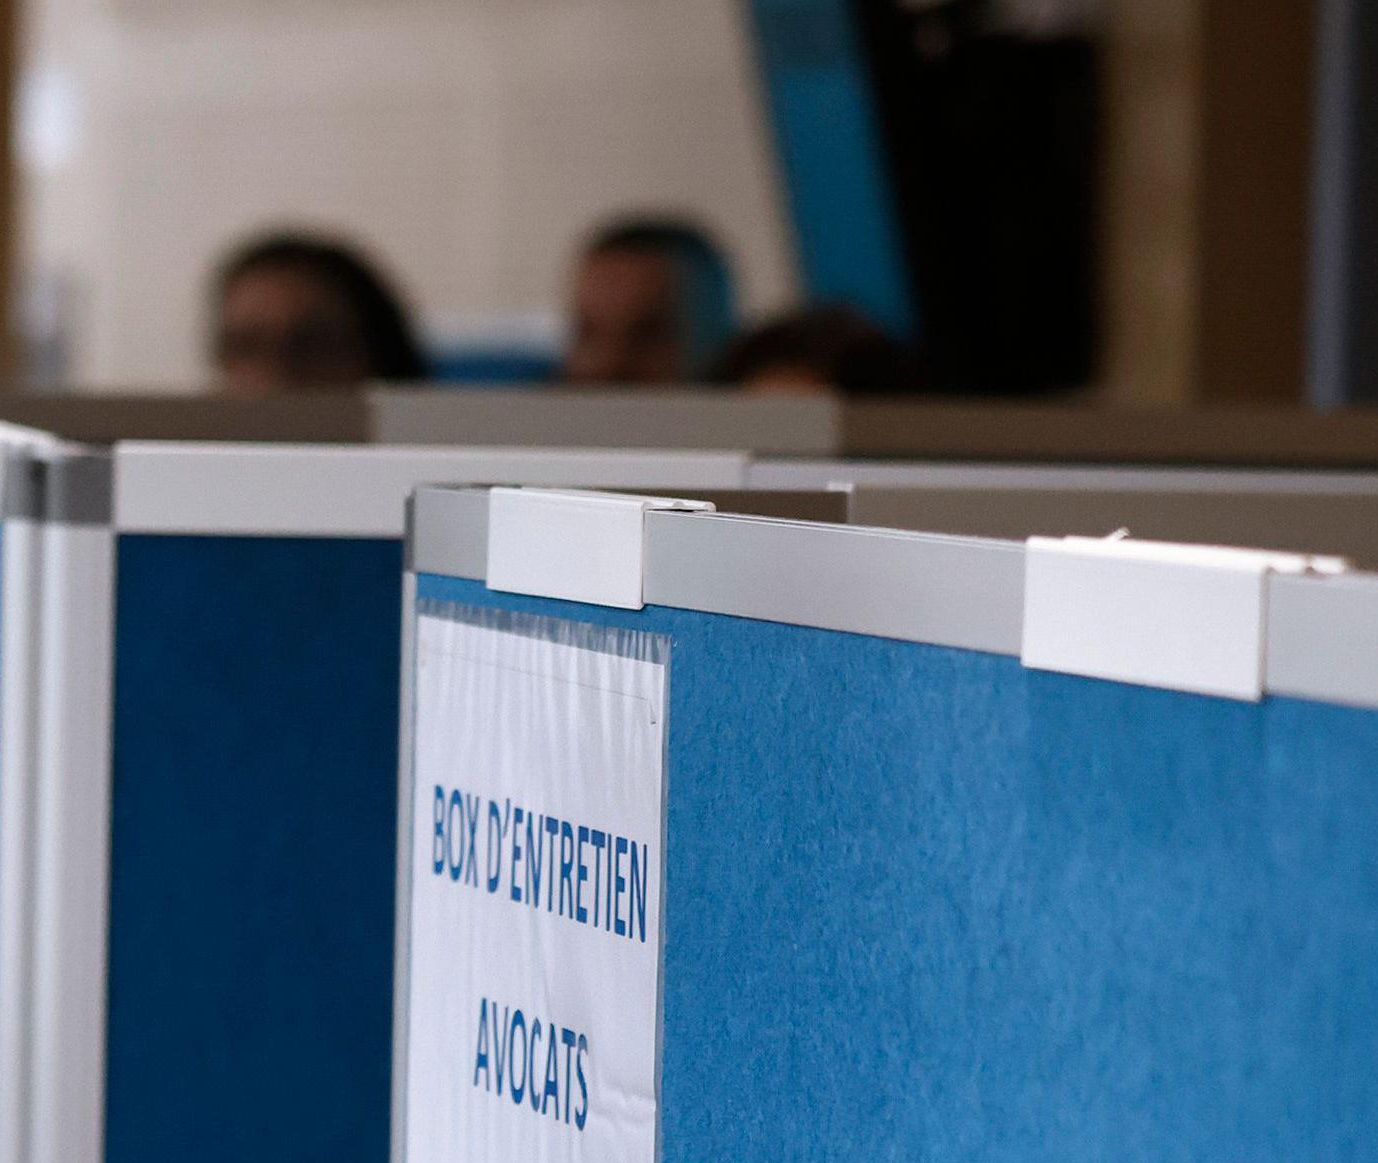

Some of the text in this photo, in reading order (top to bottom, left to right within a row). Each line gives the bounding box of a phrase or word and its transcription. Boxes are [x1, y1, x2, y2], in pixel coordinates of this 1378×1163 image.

[432, 784, 648, 944] BOX D'ENTRETIEN
[474, 998, 589, 1131] AVOCATS
